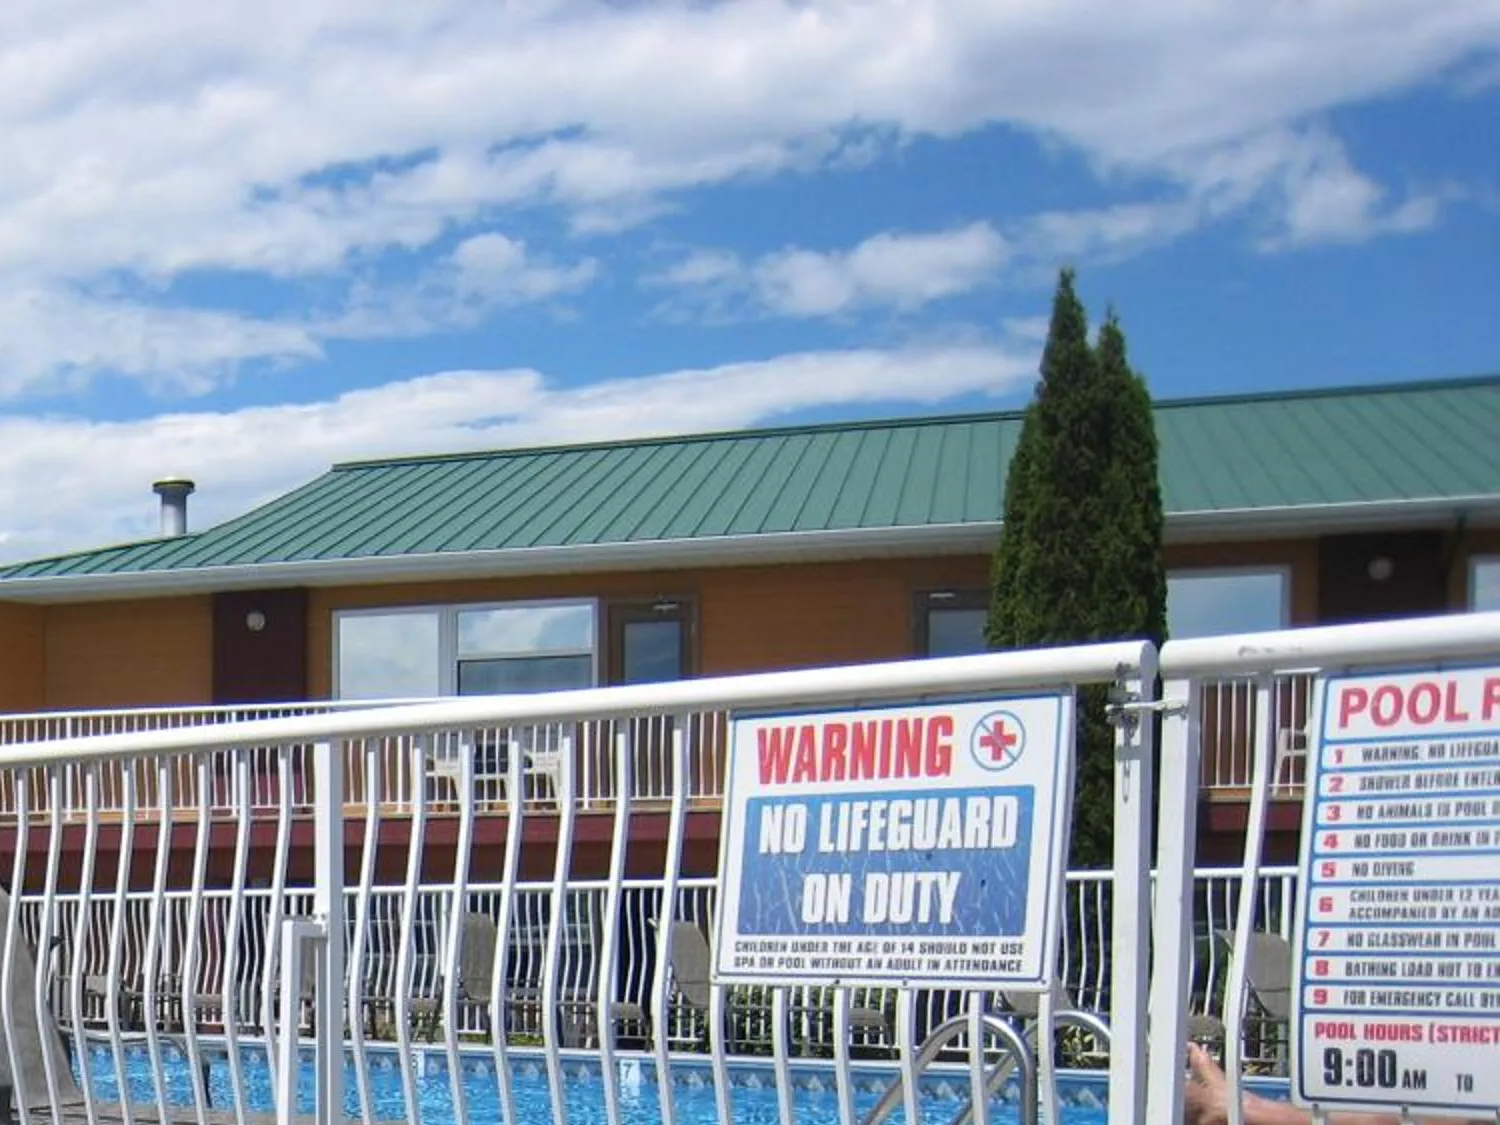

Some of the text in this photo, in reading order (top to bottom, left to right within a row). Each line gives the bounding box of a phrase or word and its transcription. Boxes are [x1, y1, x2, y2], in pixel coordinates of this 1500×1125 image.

[1339, 680, 1469, 728] POOL
[757, 716, 955, 785] WARNING
[1334, 749, 1344, 764] 1
[1428, 743, 1445, 758] NO
[1328, 776, 1344, 793] 2
[1359, 774, 1411, 791] SHOWER
[1414, 772, 1459, 789] BEFORE
[1326, 805, 1341, 821] 3
[1357, 804, 1374, 820] NO
[1378, 802, 1433, 819] ANIMALS
[1437, 801, 1451, 817] IN
[1455, 800, 1487, 817] POOL
[759, 795, 1019, 853] NO LIFEGUARD
[1323, 833, 1338, 849] 4
[1354, 833, 1371, 848] NO
[1375, 832, 1407, 848] FOOD
[1411, 831, 1428, 848] OR
[1432, 831, 1471, 847] DRINK
[1476, 830, 1490, 845] IN
[1321, 861, 1415, 878] 5 NO DIVING
[801, 871, 963, 925] ON DUTY
[1318, 896, 1334, 912] 6
[1349, 888, 1409, 902] CHILDREN
[1413, 888, 1453, 902] UNDER
[1459, 888, 1473, 902] 12
[1348, 906, 1437, 919] ACCOMPANIED
[1442, 906, 1458, 920] BY
[1462, 906, 1479, 919] AN
[734, 940, 1023, 955] CHILDREN UNDER THE AGE OF 14 SHOULD NOT USE
[1317, 931, 1496, 948] 7 NO GLASSWEAR IN POOL
[733, 955, 1023, 972] SPA OR POOL WITHOUT AN ADULT IN ATTENDANCE
[1315, 960, 1329, 976] 8
[1345, 960, 1397, 977] BATHING
[1401, 960, 1433, 977] LOAD
[1437, 961, 1462, 977] NOT
[1467, 962, 1483, 977] TO
[1313, 989, 1328, 1005] 9
[1343, 990, 1366, 1005] FOR
[1370, 990, 1441, 1007] EMERGENCY
[1445, 992, 1475, 1008] CALL
[1314, 1022, 1357, 1040] POOL
[1363, 1022, 1423, 1042] HOURS
[1323, 1047, 1474, 1092] 9:00 AM TO
